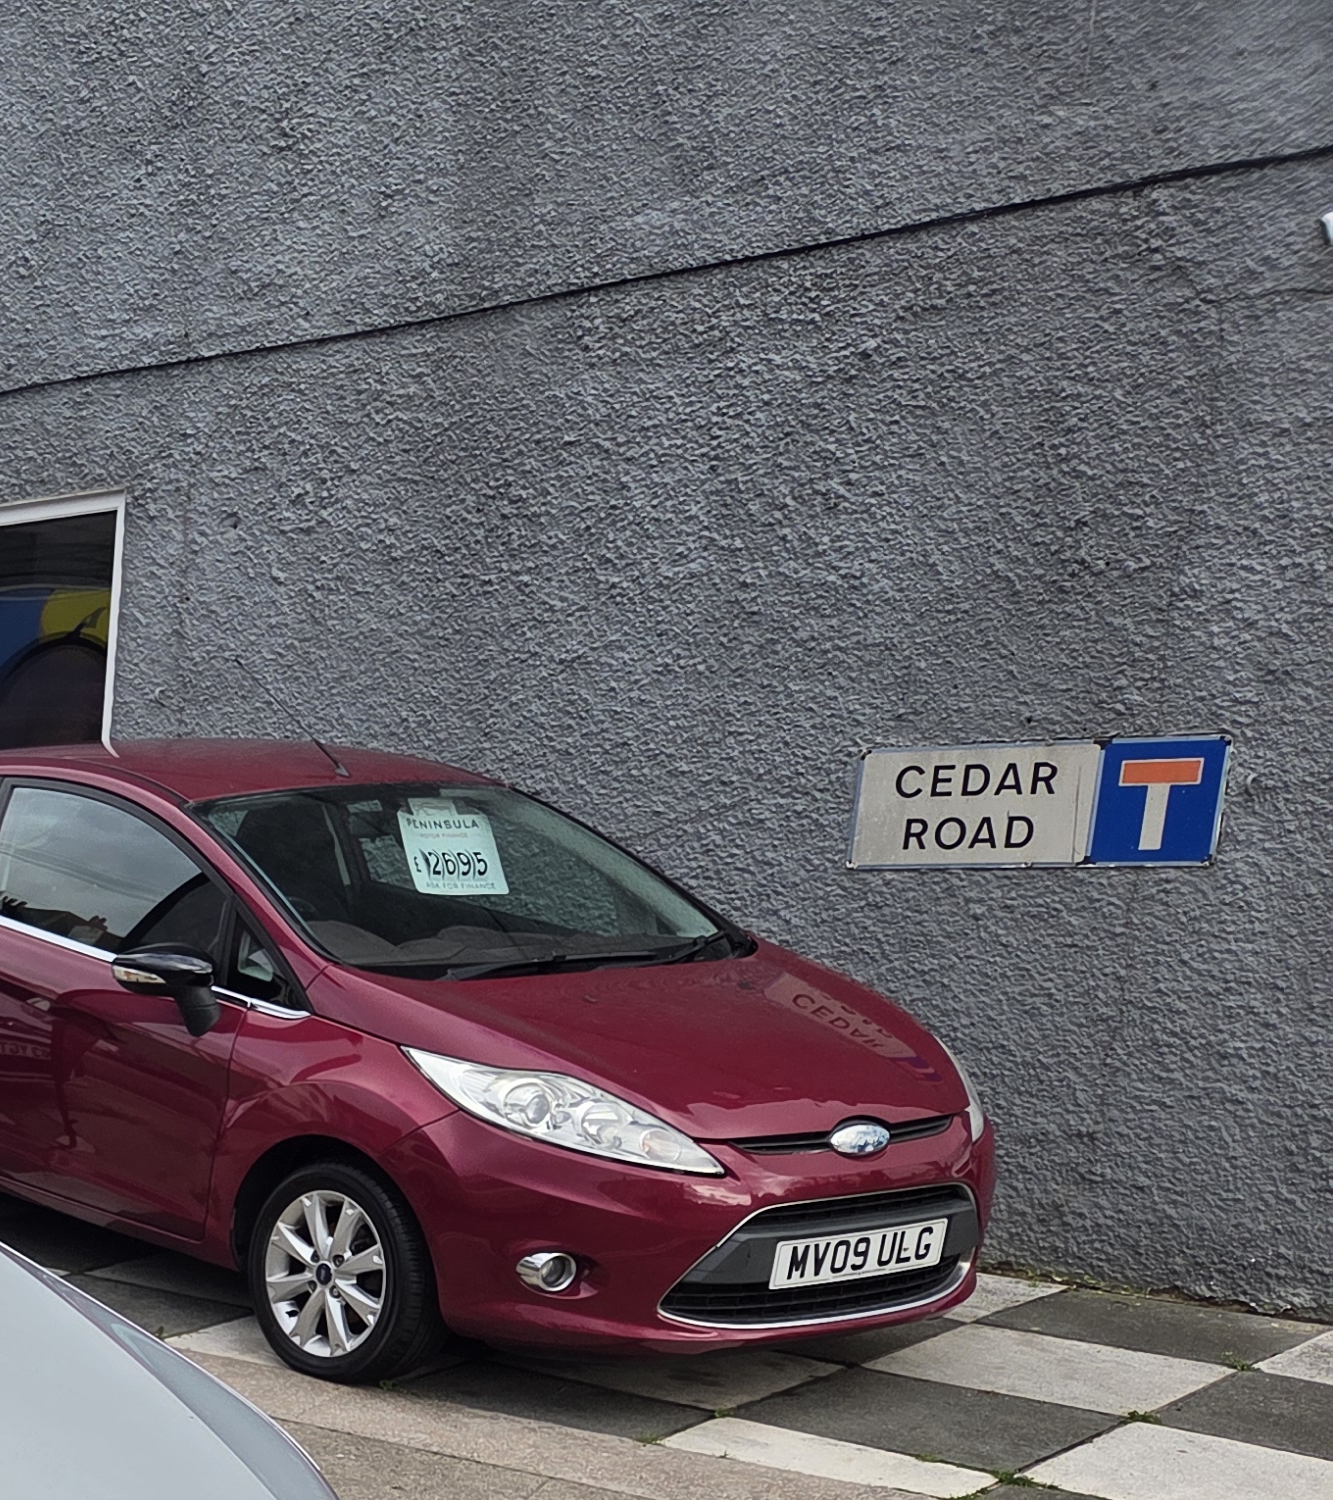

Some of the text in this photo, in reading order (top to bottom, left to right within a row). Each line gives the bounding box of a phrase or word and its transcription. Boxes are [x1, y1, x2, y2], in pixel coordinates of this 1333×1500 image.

[895, 762, 1059, 798] CEDAR
[406, 818, 480, 829] PENINSULA
[902, 816, 1034, 850] ROAD
[427, 852, 488, 876] 2695
[787, 1226, 933, 1280] MV09 ULG
